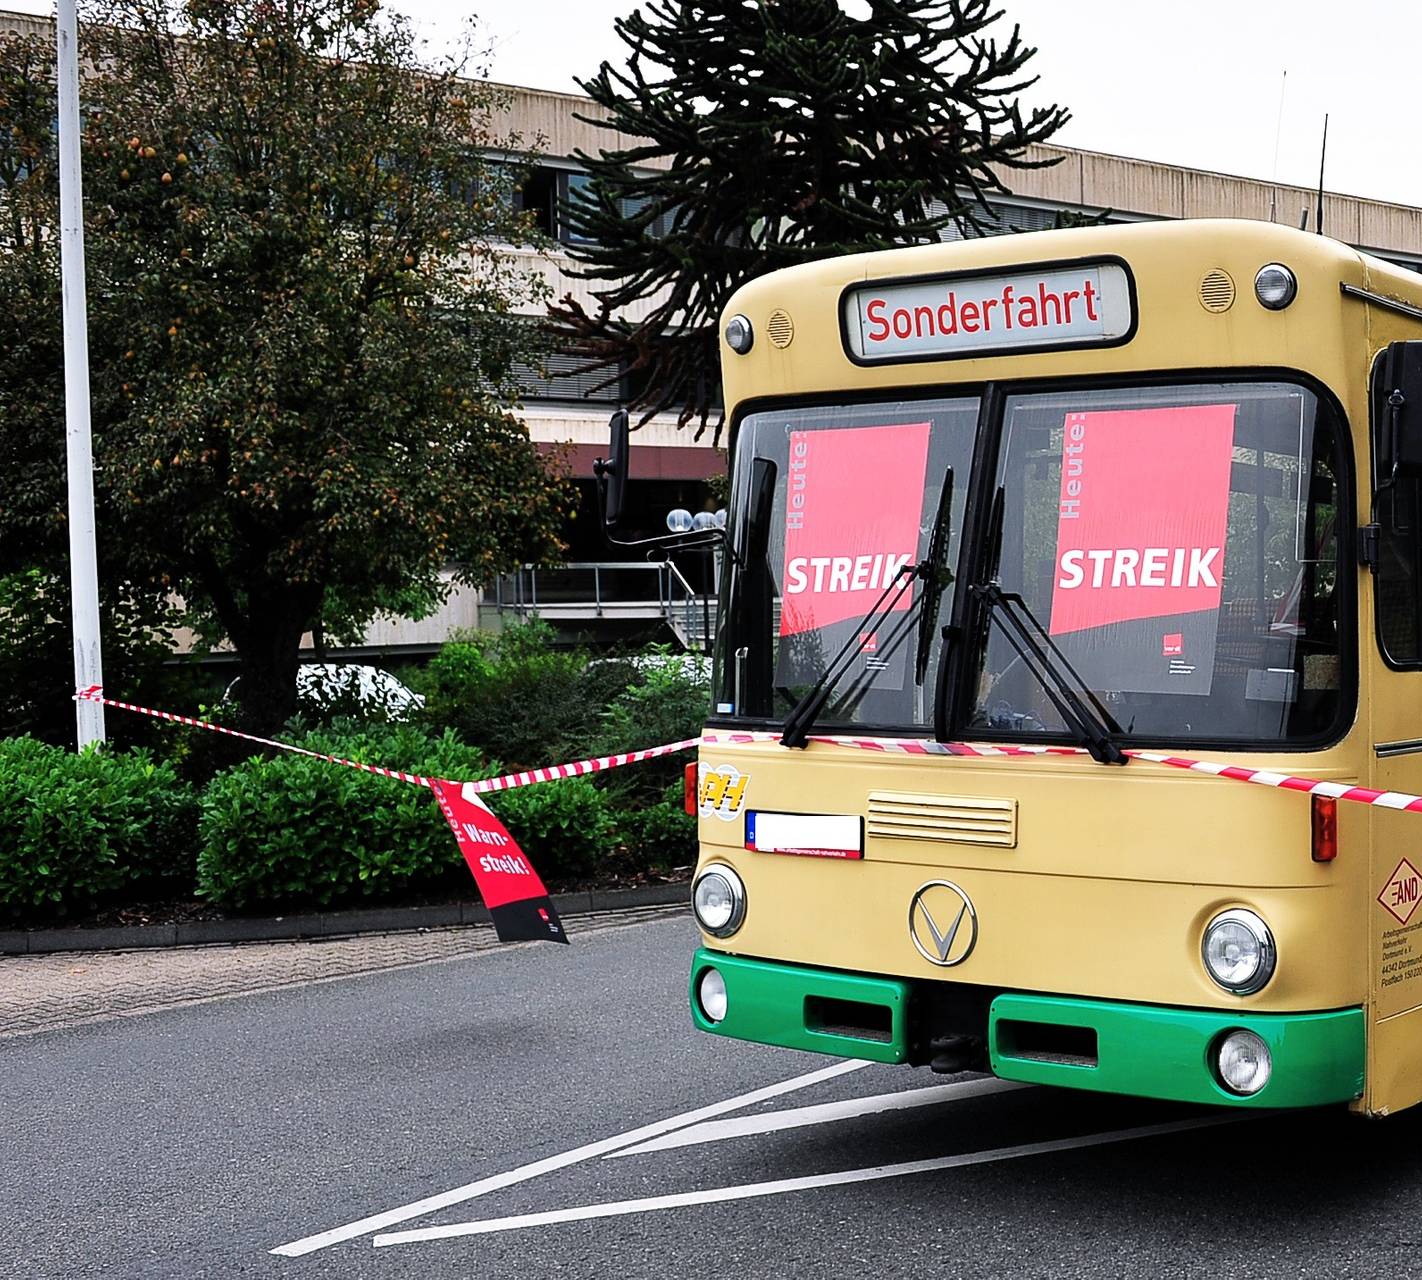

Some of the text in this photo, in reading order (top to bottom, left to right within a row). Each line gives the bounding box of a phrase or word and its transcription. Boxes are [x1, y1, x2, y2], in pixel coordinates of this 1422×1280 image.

[867, 281, 1098, 341] Sonderfahrt
[1059, 414, 1085, 519] Heute:
[787, 553, 912, 593] STREIK
[1059, 548, 1220, 589] STREIK
[462, 823, 508, 846] Warn-
[480, 853, 530, 875] streik!
